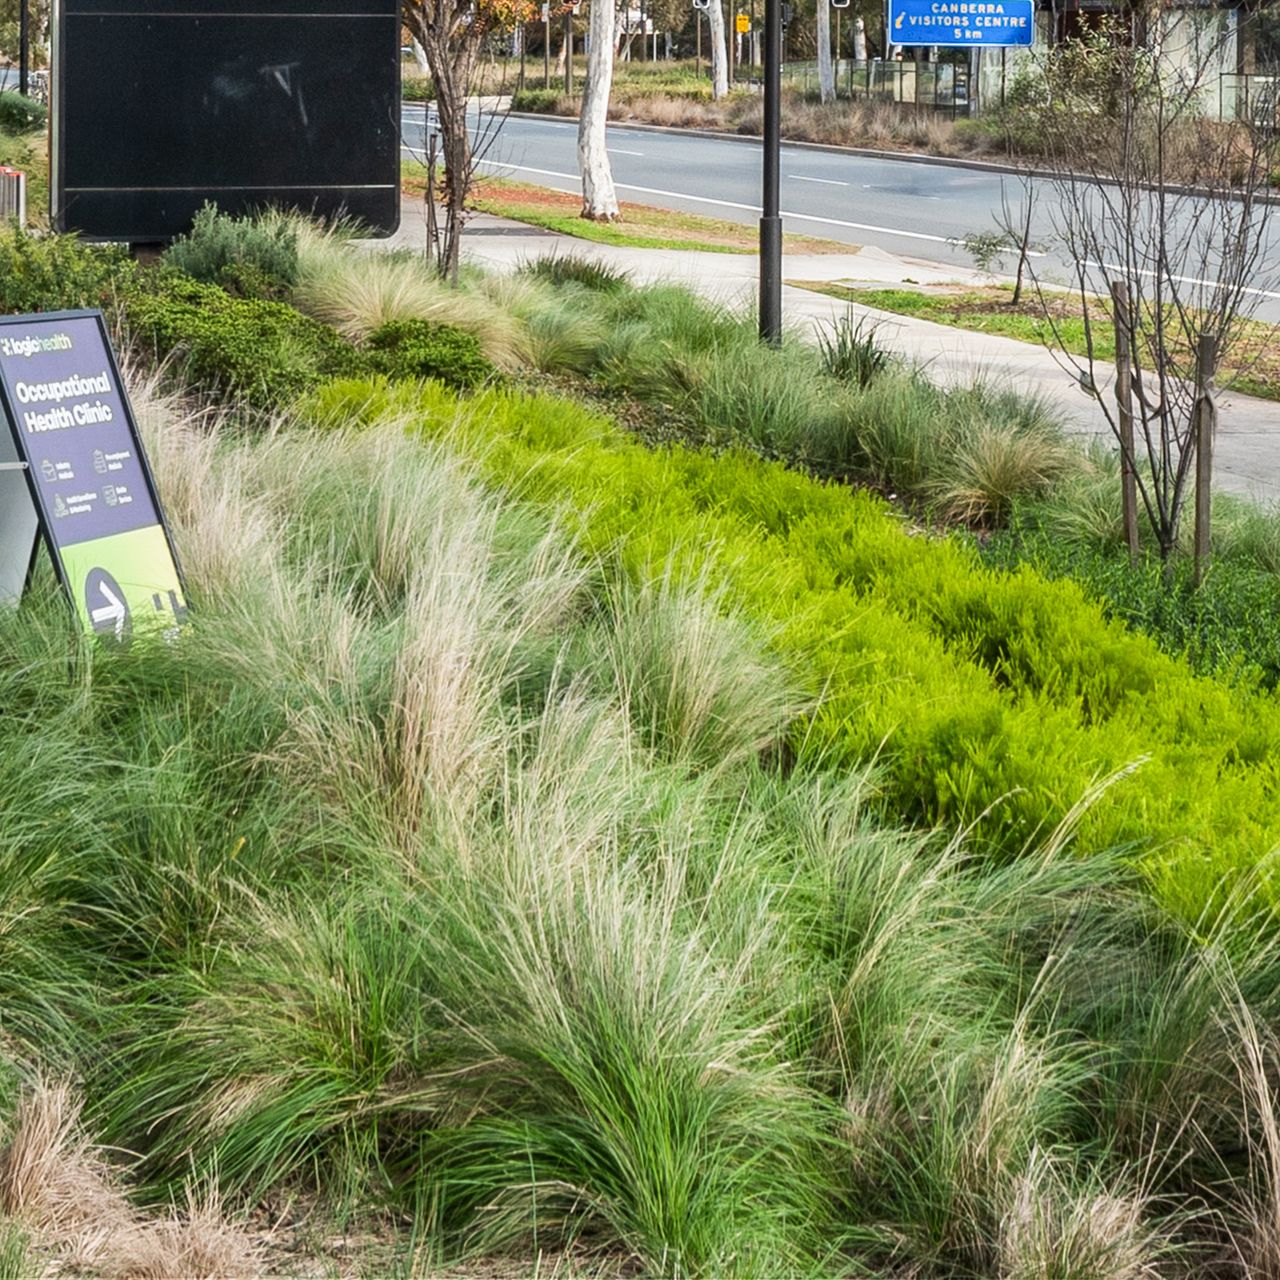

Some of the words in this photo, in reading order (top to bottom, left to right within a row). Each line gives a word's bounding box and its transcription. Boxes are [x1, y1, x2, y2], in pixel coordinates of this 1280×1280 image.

[931, 2, 1005, 14] CANBERRA
[909, 15, 970, 26] VISITORS
[975, 17, 1027, 27] CENTRE
[954, 28, 962, 39] 5
[964, 28, 983, 39] km
[10, 333, 72, 357] logichealth
[16, 371, 111, 404] Occupational
[23, 406, 76, 433] Health
[73, 400, 113, 425] Clinic
